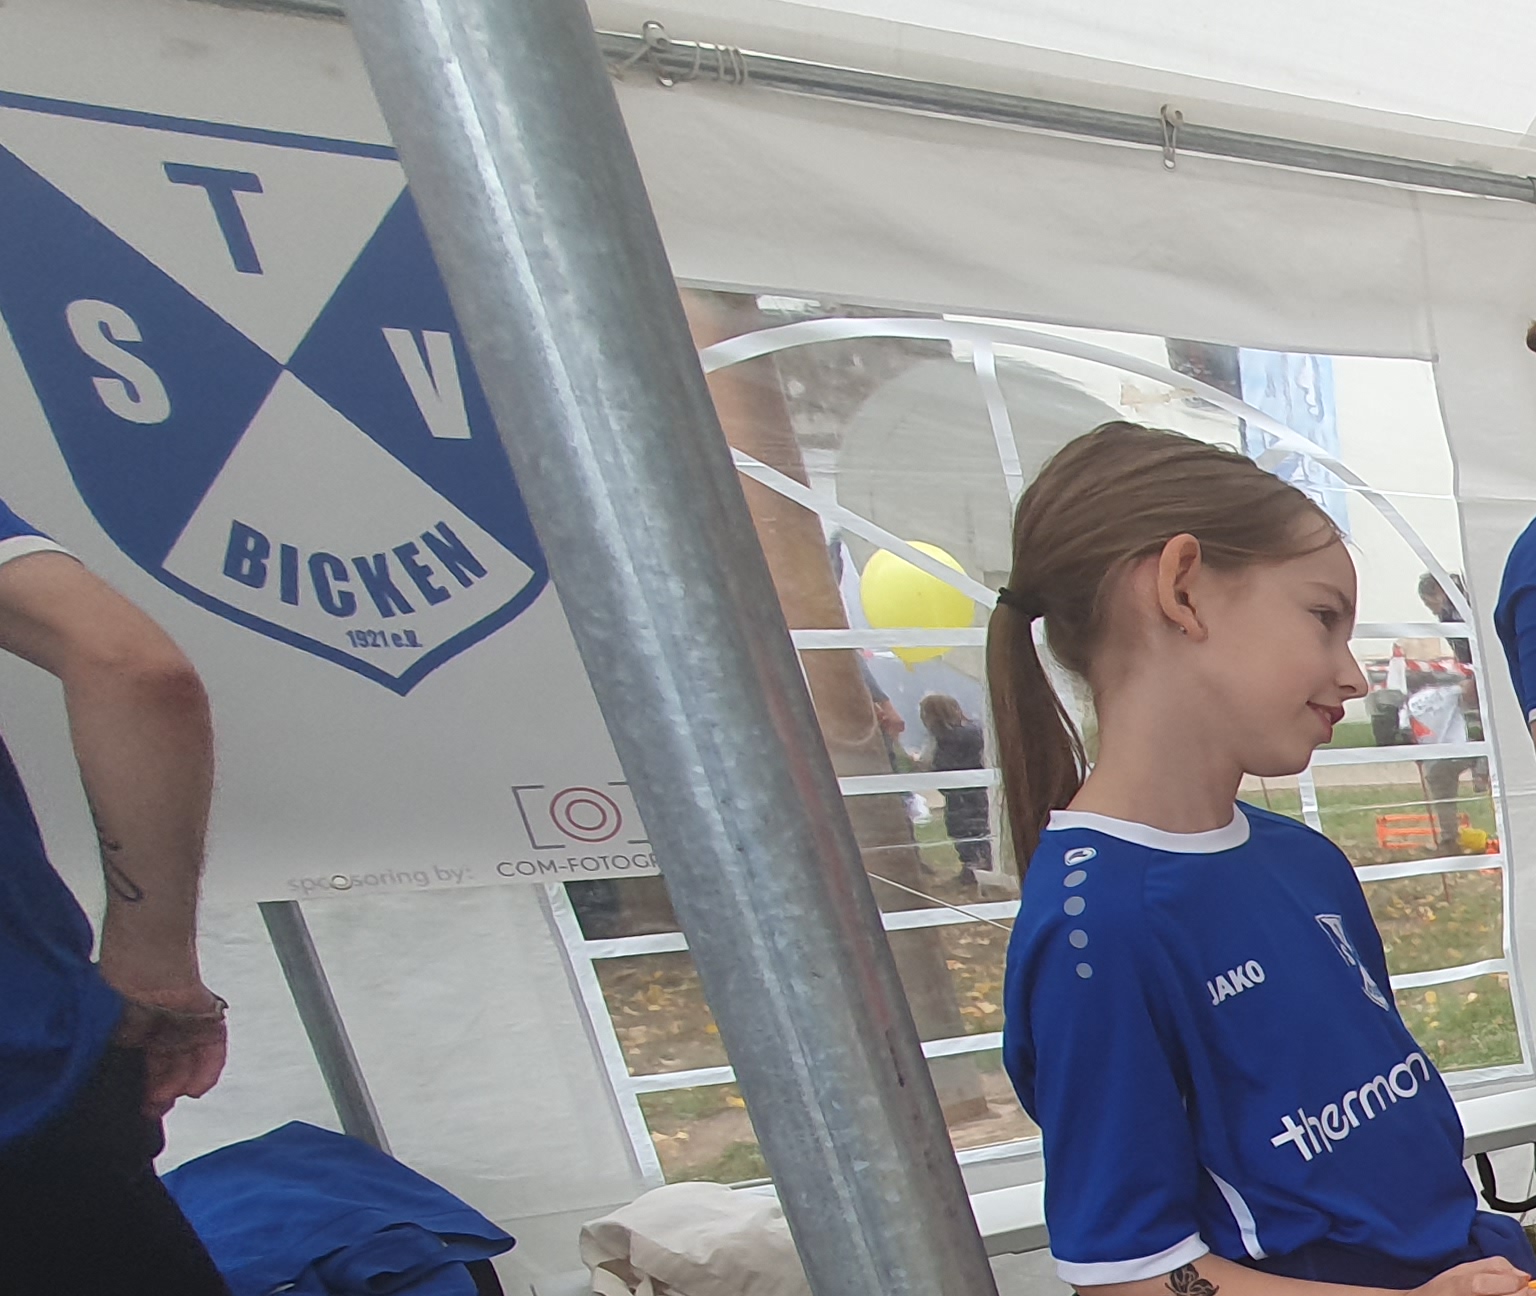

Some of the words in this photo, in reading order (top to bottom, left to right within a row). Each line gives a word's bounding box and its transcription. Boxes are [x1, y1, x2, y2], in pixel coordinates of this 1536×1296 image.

[162, 161, 264, 275] T
[65, 298, 172, 426] S
[381, 327, 472, 440] V
[222, 518, 489, 619] BICKEN
[346, 630, 388, 648] 1921
[1206, 959, 1266, 1007] JAKO
